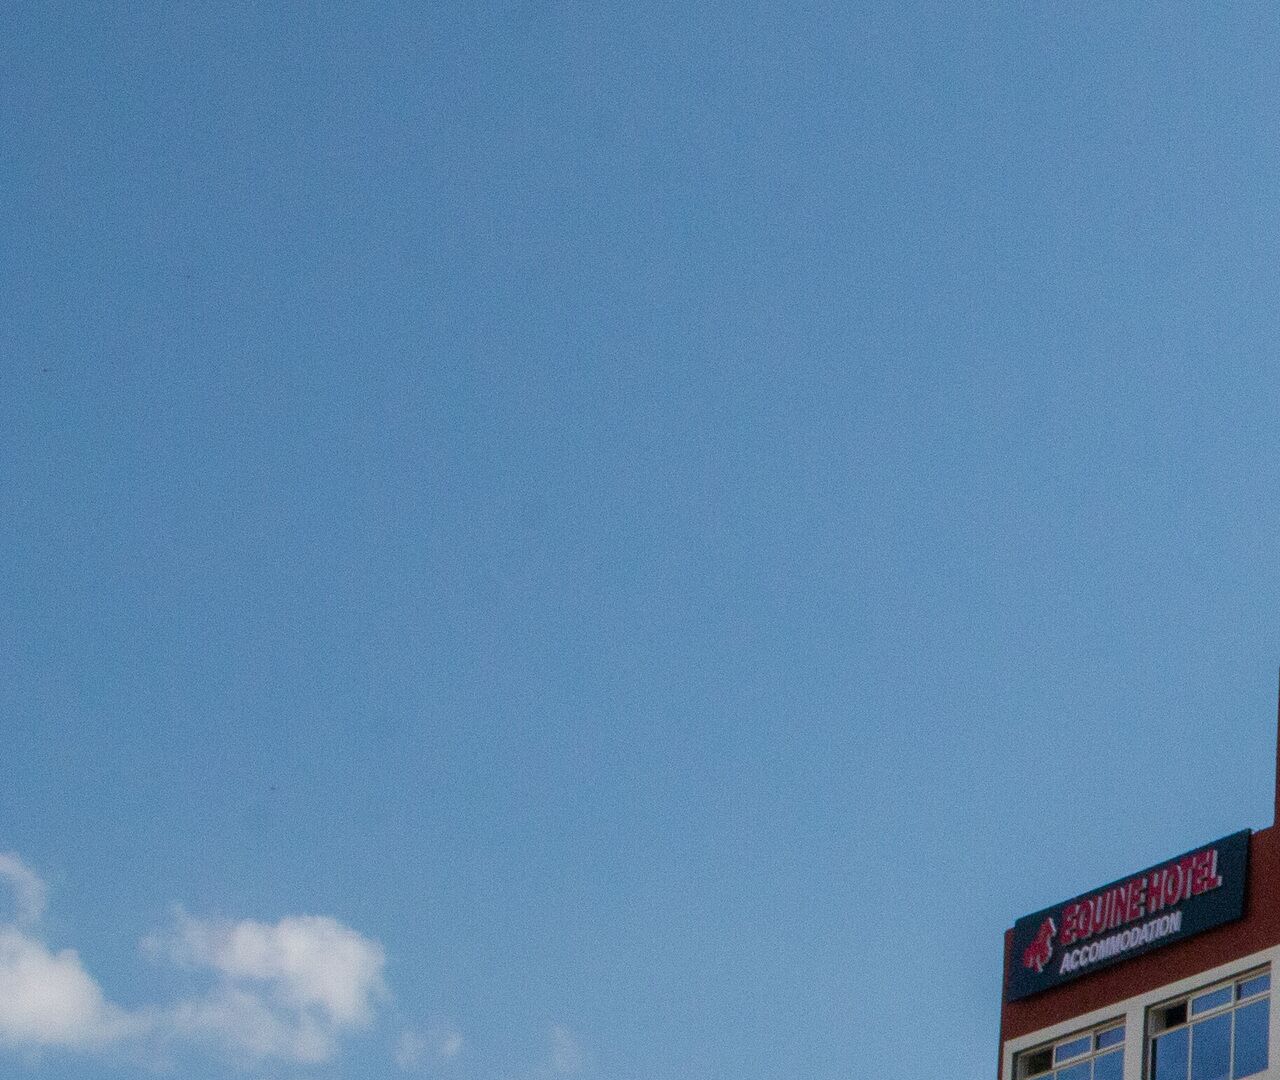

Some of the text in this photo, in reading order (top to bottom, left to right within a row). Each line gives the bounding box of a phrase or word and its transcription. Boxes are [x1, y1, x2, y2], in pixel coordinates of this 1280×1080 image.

[1060, 849, 1222, 945] EQUINE HOTEL
[1059, 911, 1183, 975] ACCOMMODATION
